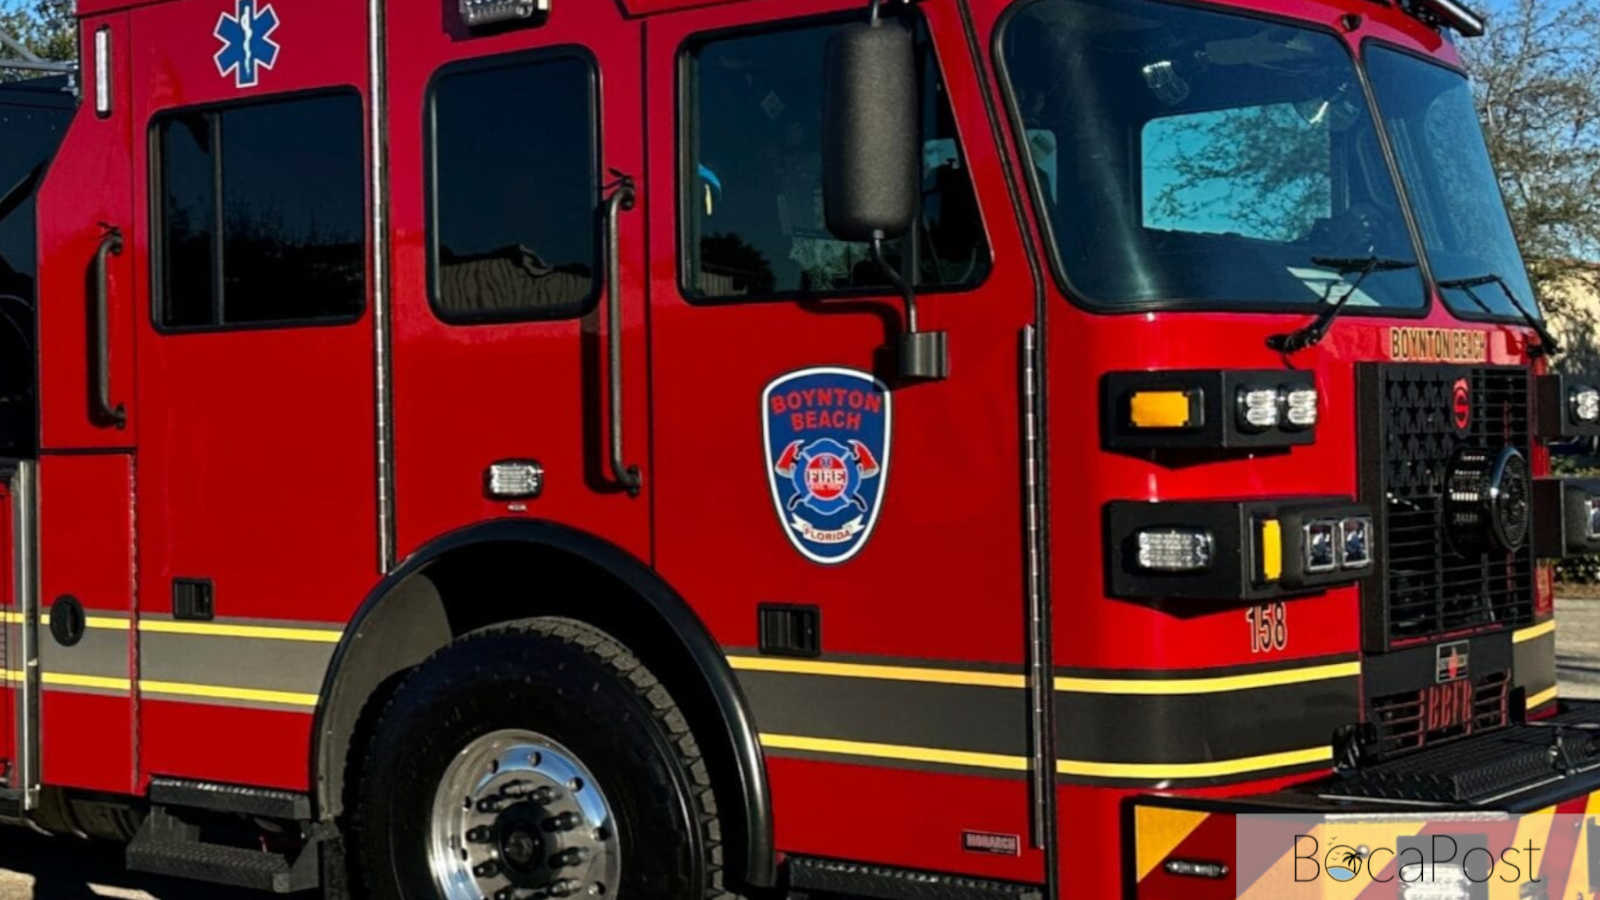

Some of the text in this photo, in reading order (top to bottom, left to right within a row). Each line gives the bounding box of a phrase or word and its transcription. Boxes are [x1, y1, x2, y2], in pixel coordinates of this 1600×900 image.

[1390, 327, 1487, 362] BOYNTON BEACH
[771, 388, 881, 414] BOYNTON
[791, 411, 861, 430] BEACH
[806, 470, 846, 484] FIRE
[804, 527, 851, 541] FLORIDA
[1246, 602, 1288, 653] 158
